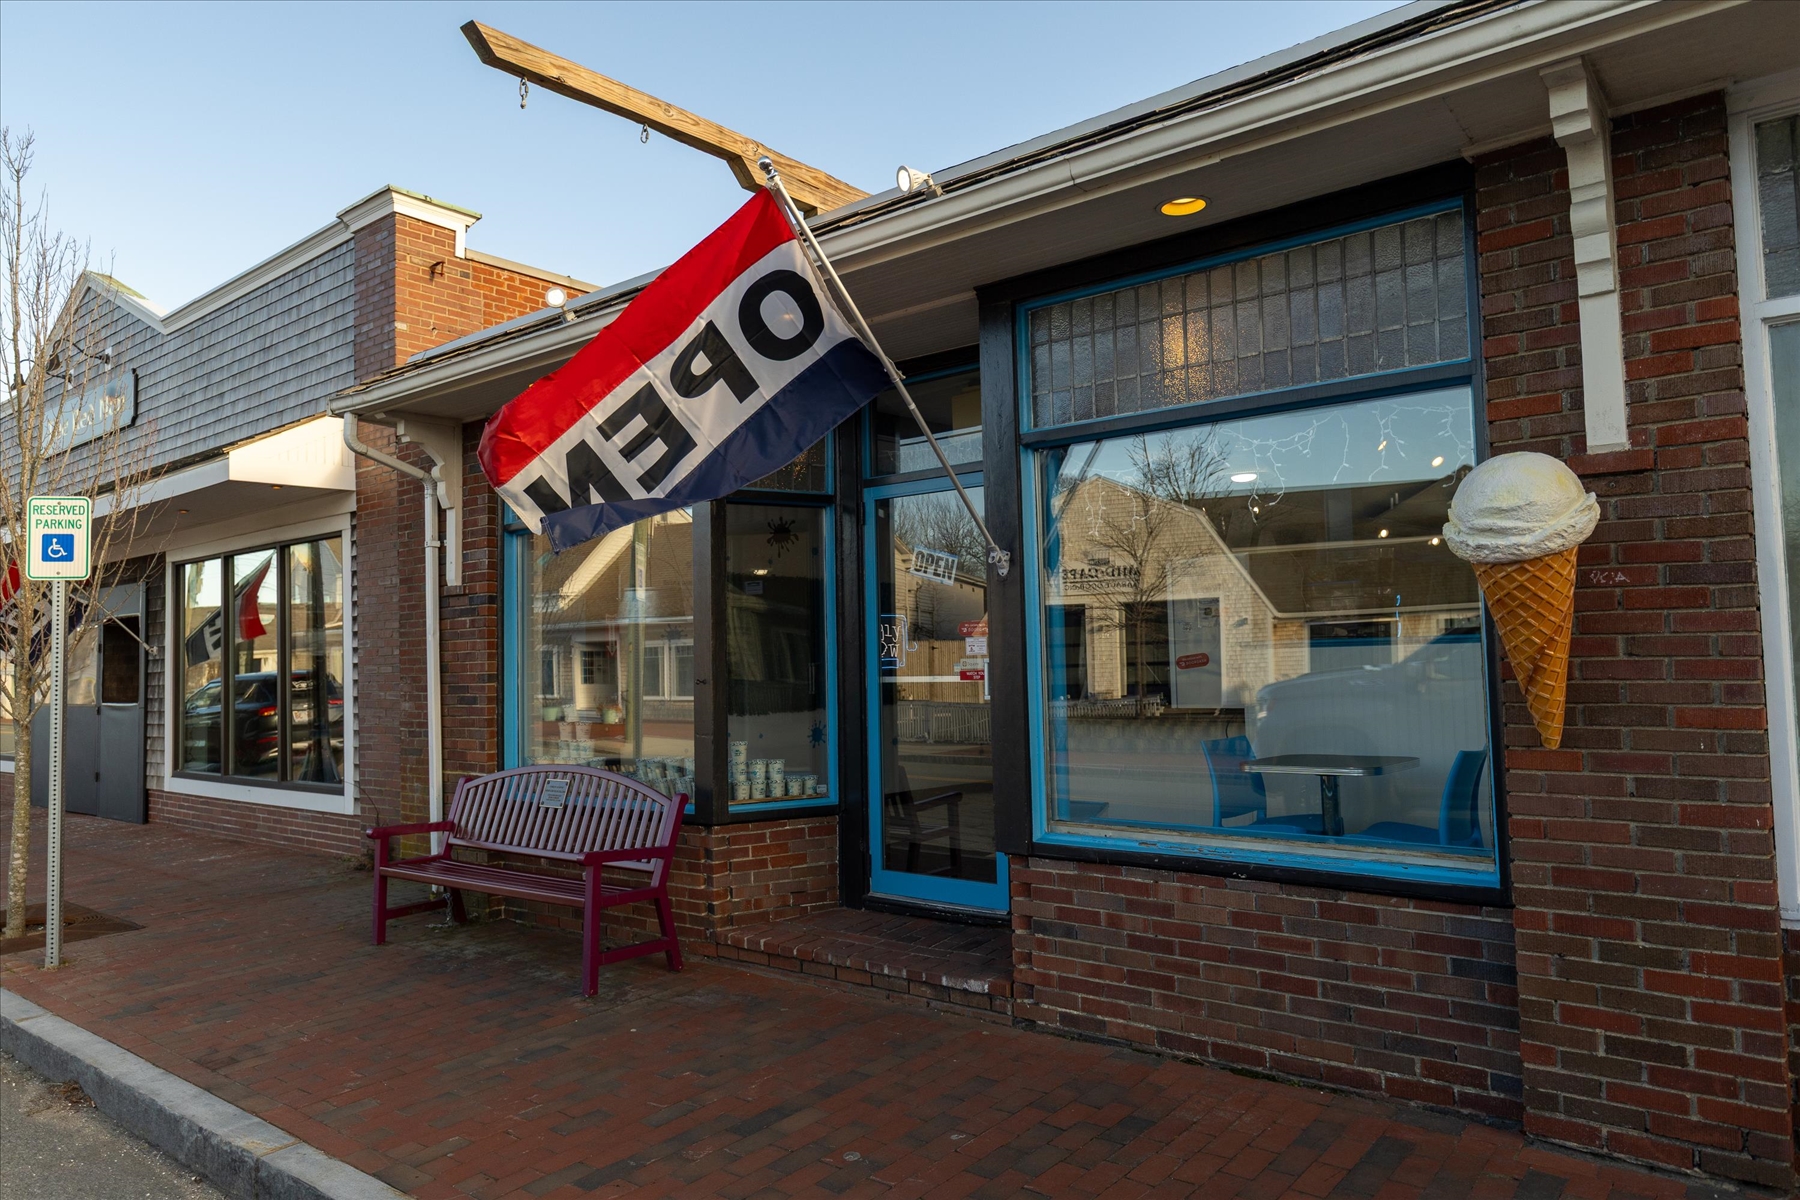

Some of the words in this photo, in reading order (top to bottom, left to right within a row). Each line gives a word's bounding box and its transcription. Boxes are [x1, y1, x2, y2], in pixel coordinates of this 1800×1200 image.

[32, 504, 86, 516] RESERVED
[35, 518, 83, 530] PARKING
[914, 550, 956, 581] OPEN
